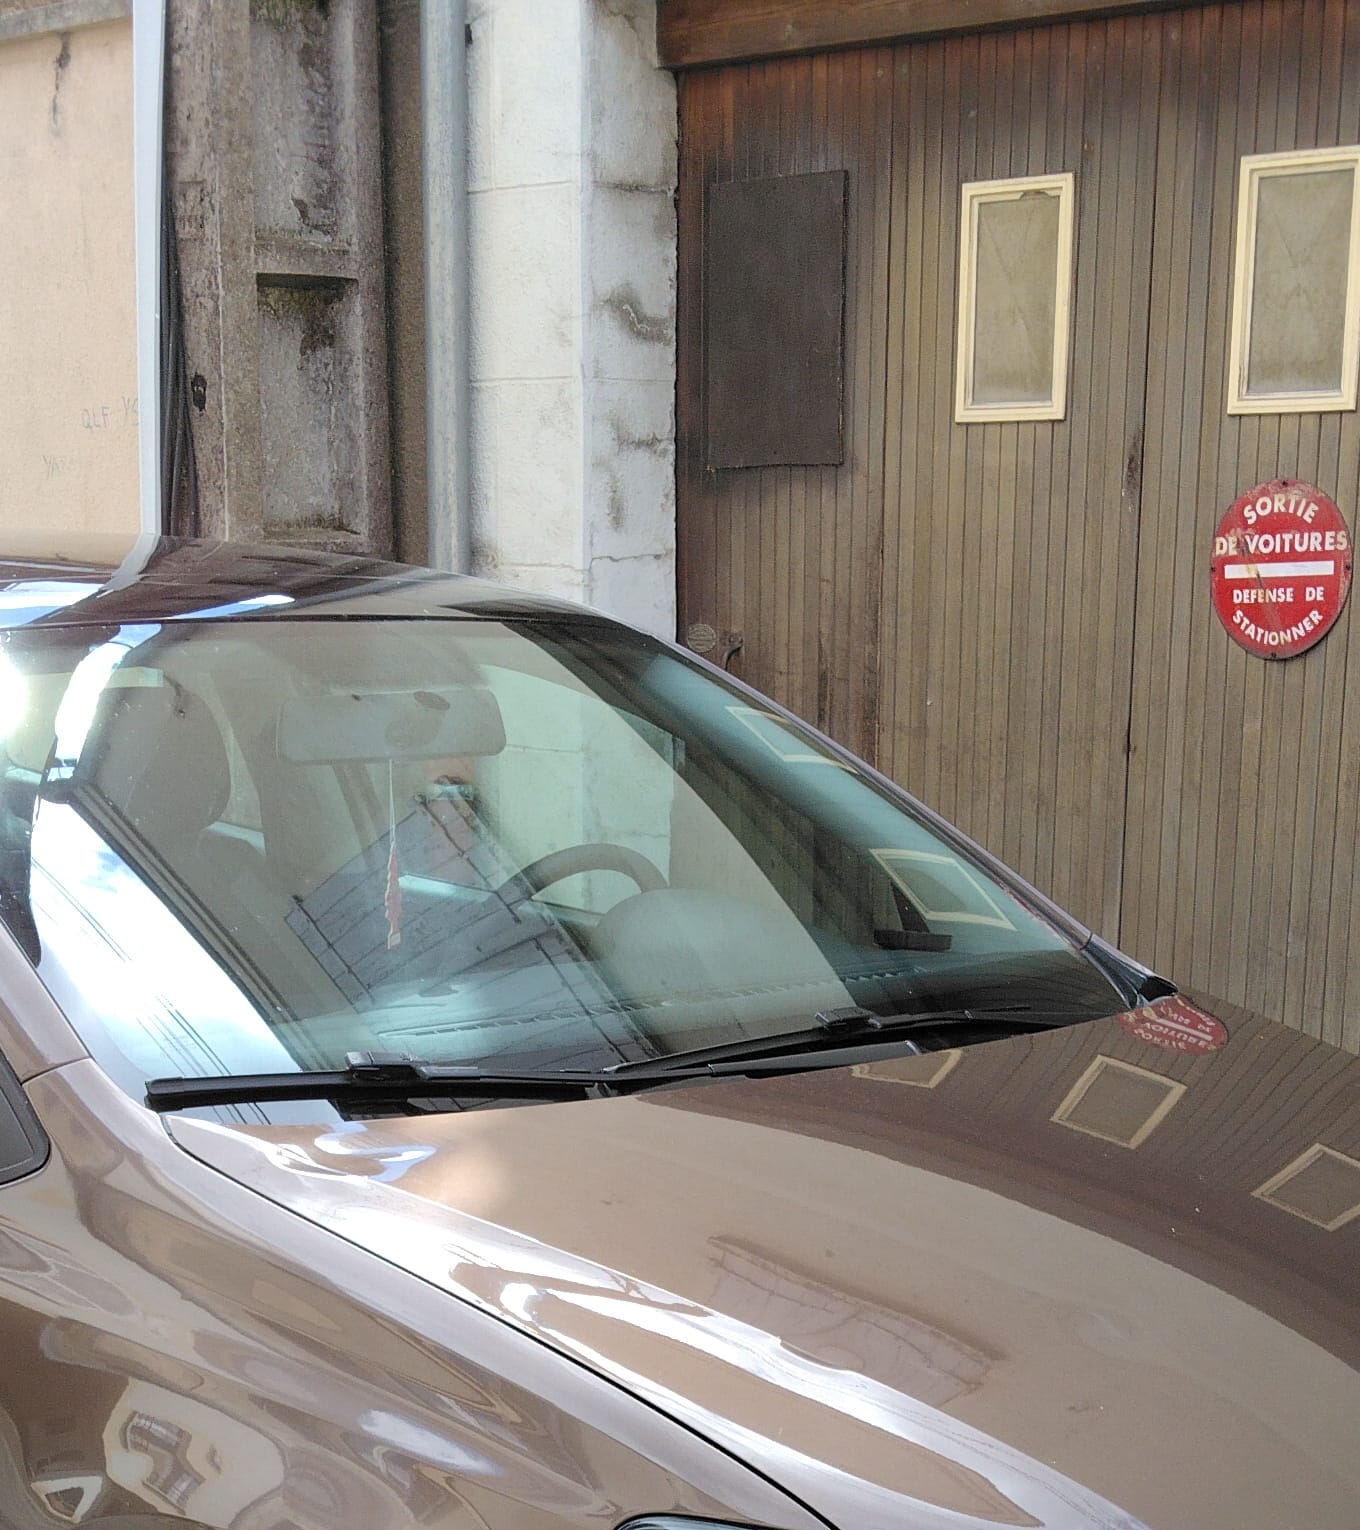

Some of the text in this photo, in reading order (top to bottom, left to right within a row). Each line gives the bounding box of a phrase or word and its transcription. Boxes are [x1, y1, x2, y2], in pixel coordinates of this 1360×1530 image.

[1244, 494, 1318, 525] SORTIE
[1215, 530, 1348, 556] DE VOITURES
[1233, 586, 1325, 604] DEFENSE DE
[1232, 610, 1324, 646] STATIONNER
